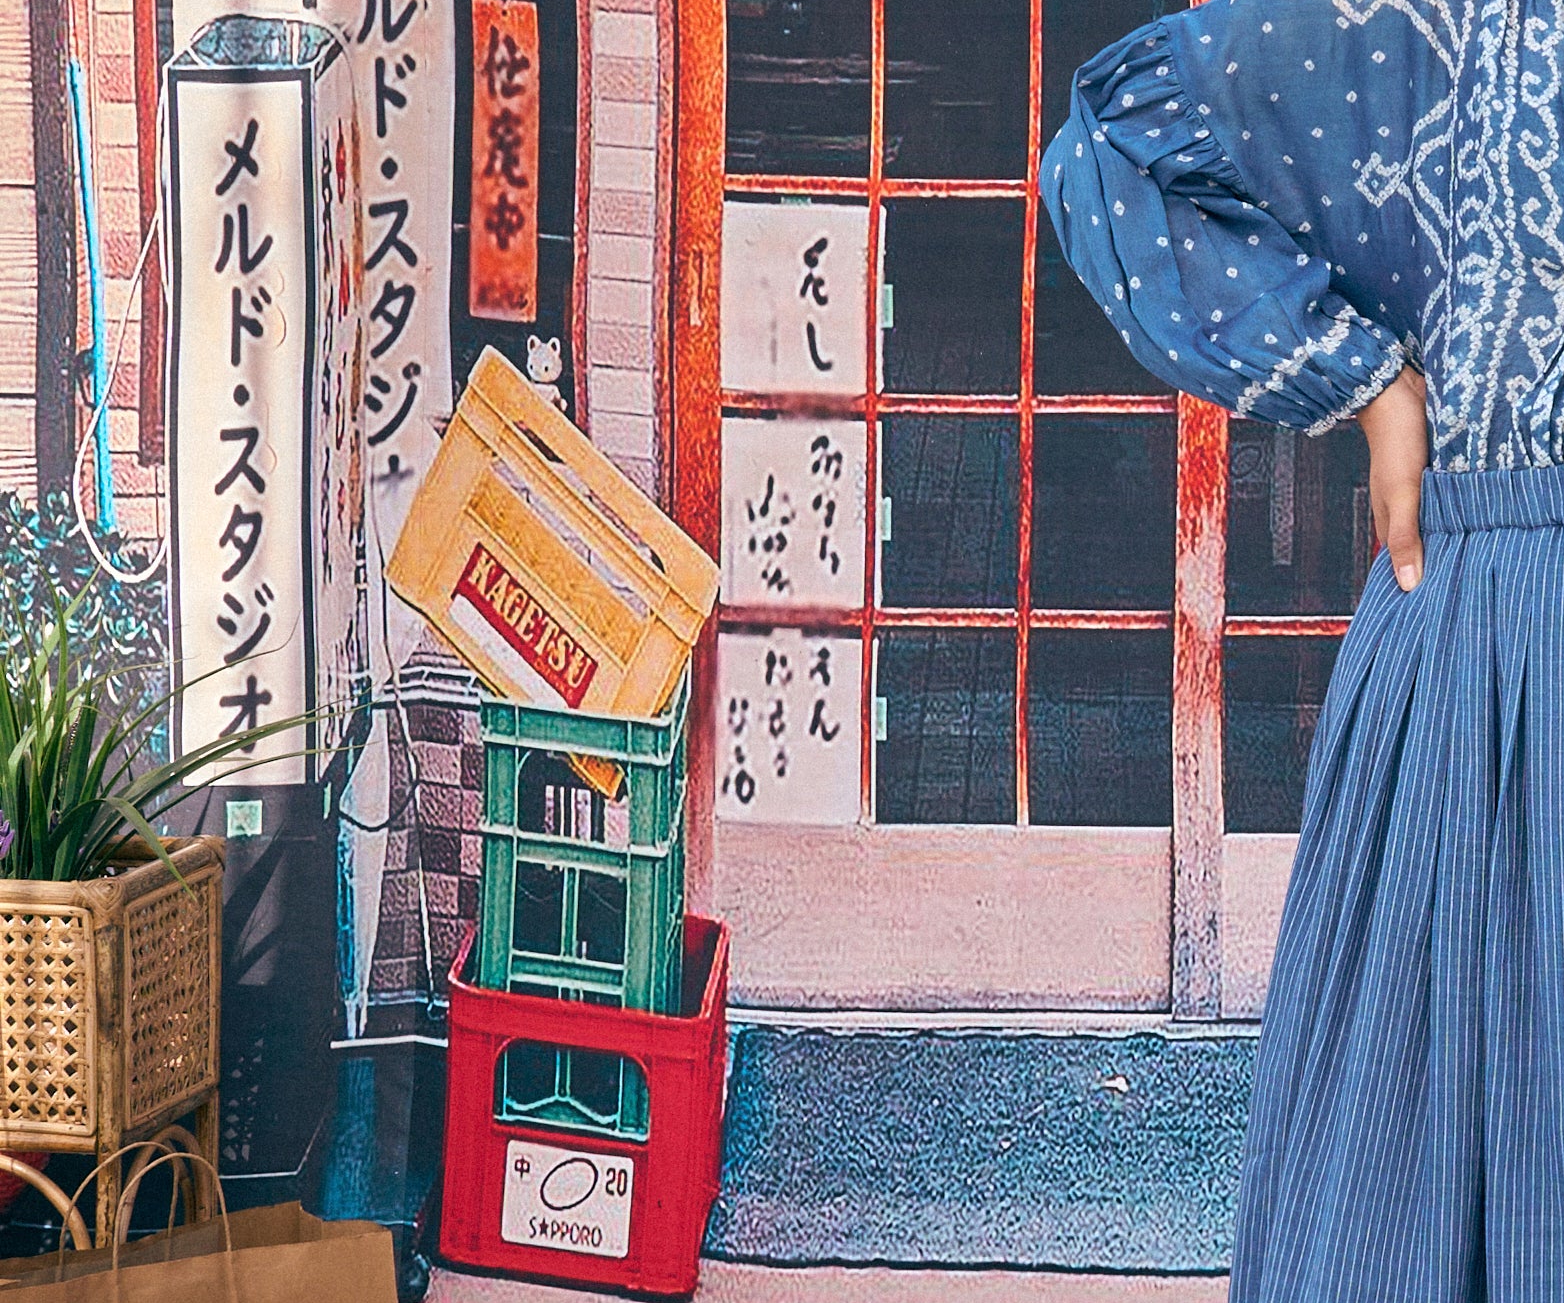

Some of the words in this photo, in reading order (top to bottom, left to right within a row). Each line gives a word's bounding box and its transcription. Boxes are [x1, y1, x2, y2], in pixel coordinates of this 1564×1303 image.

[214, 118, 275, 753] メルド・スタジオ
[605, 1167, 628, 1196] 20
